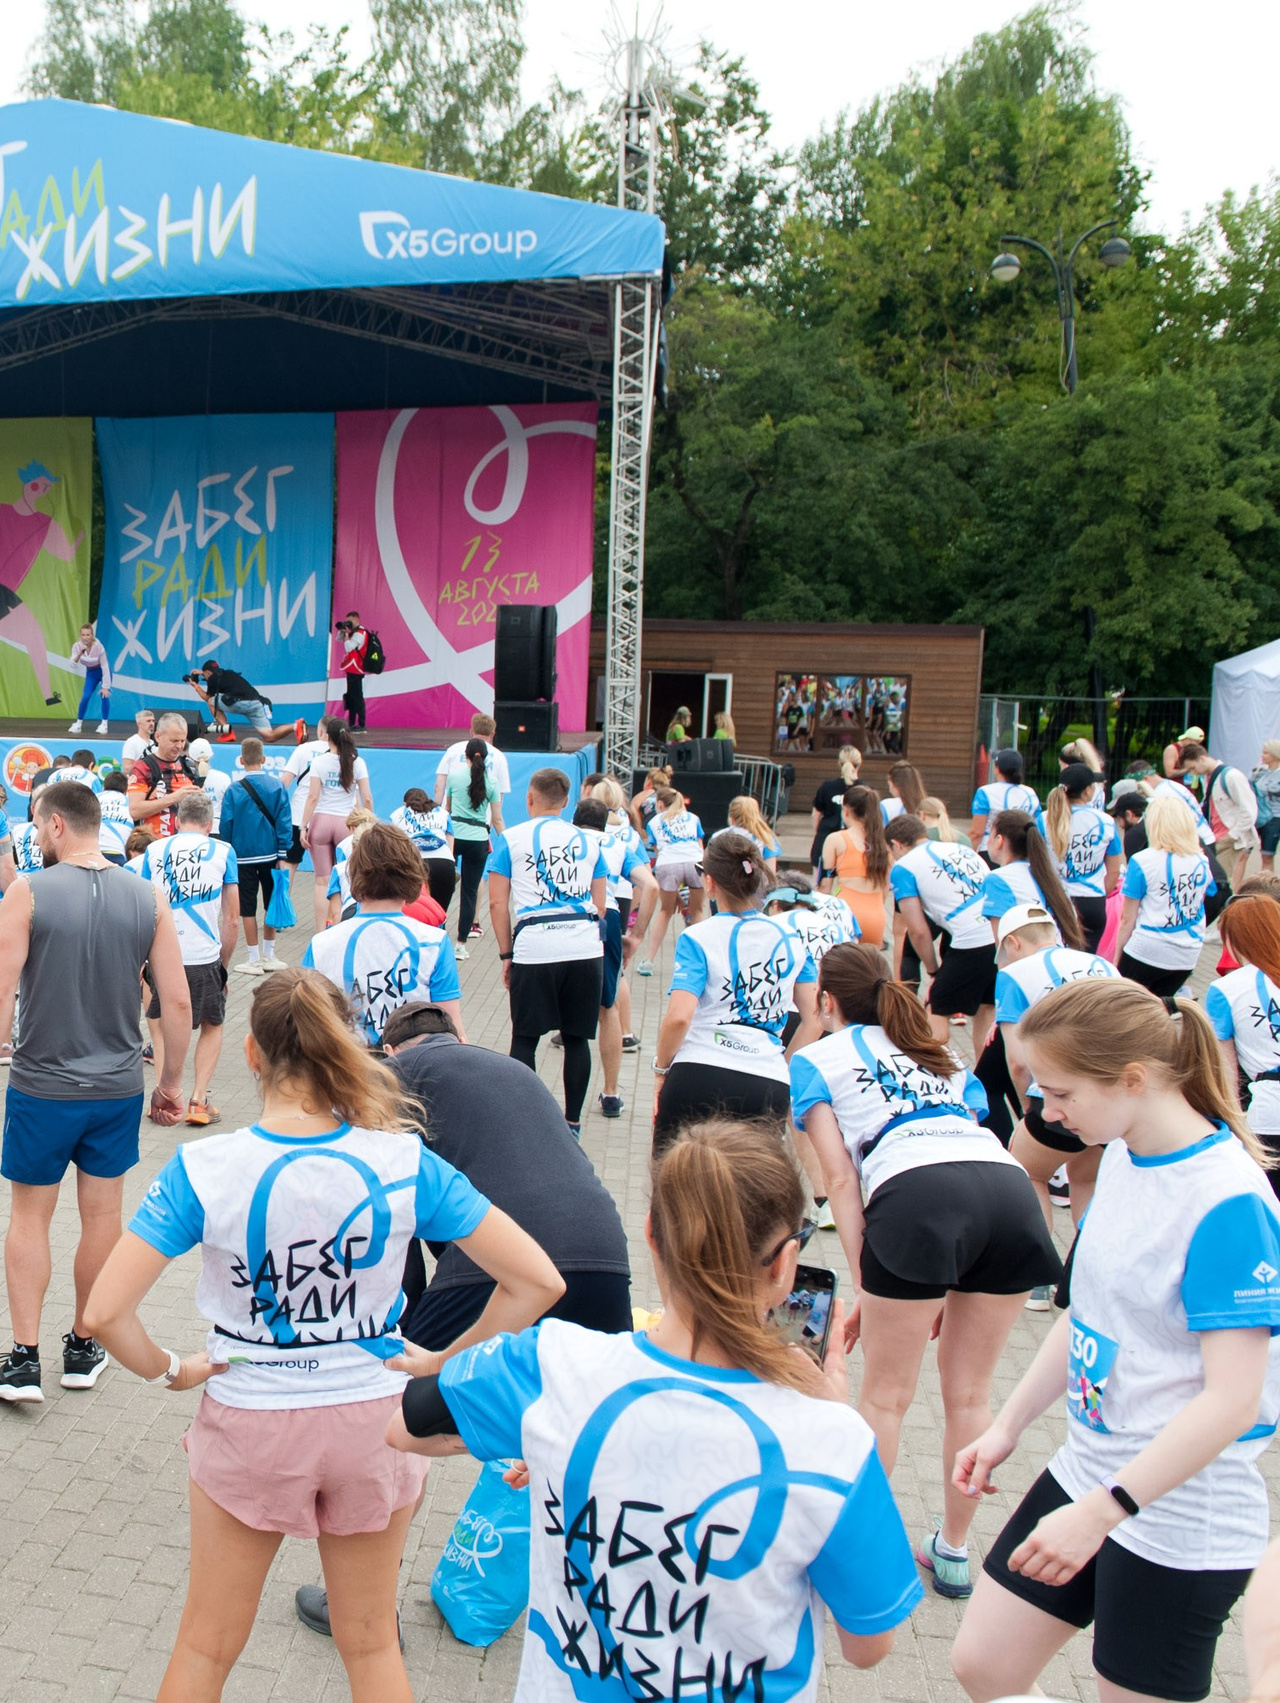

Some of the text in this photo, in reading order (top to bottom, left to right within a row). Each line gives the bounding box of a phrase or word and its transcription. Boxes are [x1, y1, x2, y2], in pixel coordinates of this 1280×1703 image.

[10, 174, 257, 301] ЖИЗНИ
[120, 465, 294, 564] ЗАБЕГ
[132, 532, 266, 610] РАДИ
[463, 530, 503, 573] 13
[438, 571, 540, 604] АВГУСТА
[111, 571, 316, 672] ЖИЗНИ
[457, 597, 513, 626] 202
[157, 849, 207, 875] ЗАБЕГ
[163, 866, 201, 886] РАДИ
[525, 846, 580, 872] ЗАБЕГ
[535, 867, 578, 885] РАДИ
[166, 884, 213, 904] ИЗНИ
[1159, 873, 1202, 897] ЗАБЕГ
[720, 957, 786, 1002] ЗАБЕГ
[231, 1235, 368, 1289] ЗАБЕГ
[250, 1281, 356, 1326] РАДИ
[544, 1478, 740, 1586] ЗАБЕГ
[563, 1555, 709, 1644] РАДИ
[556, 1605, 767, 1703] ЖИЗНИ
